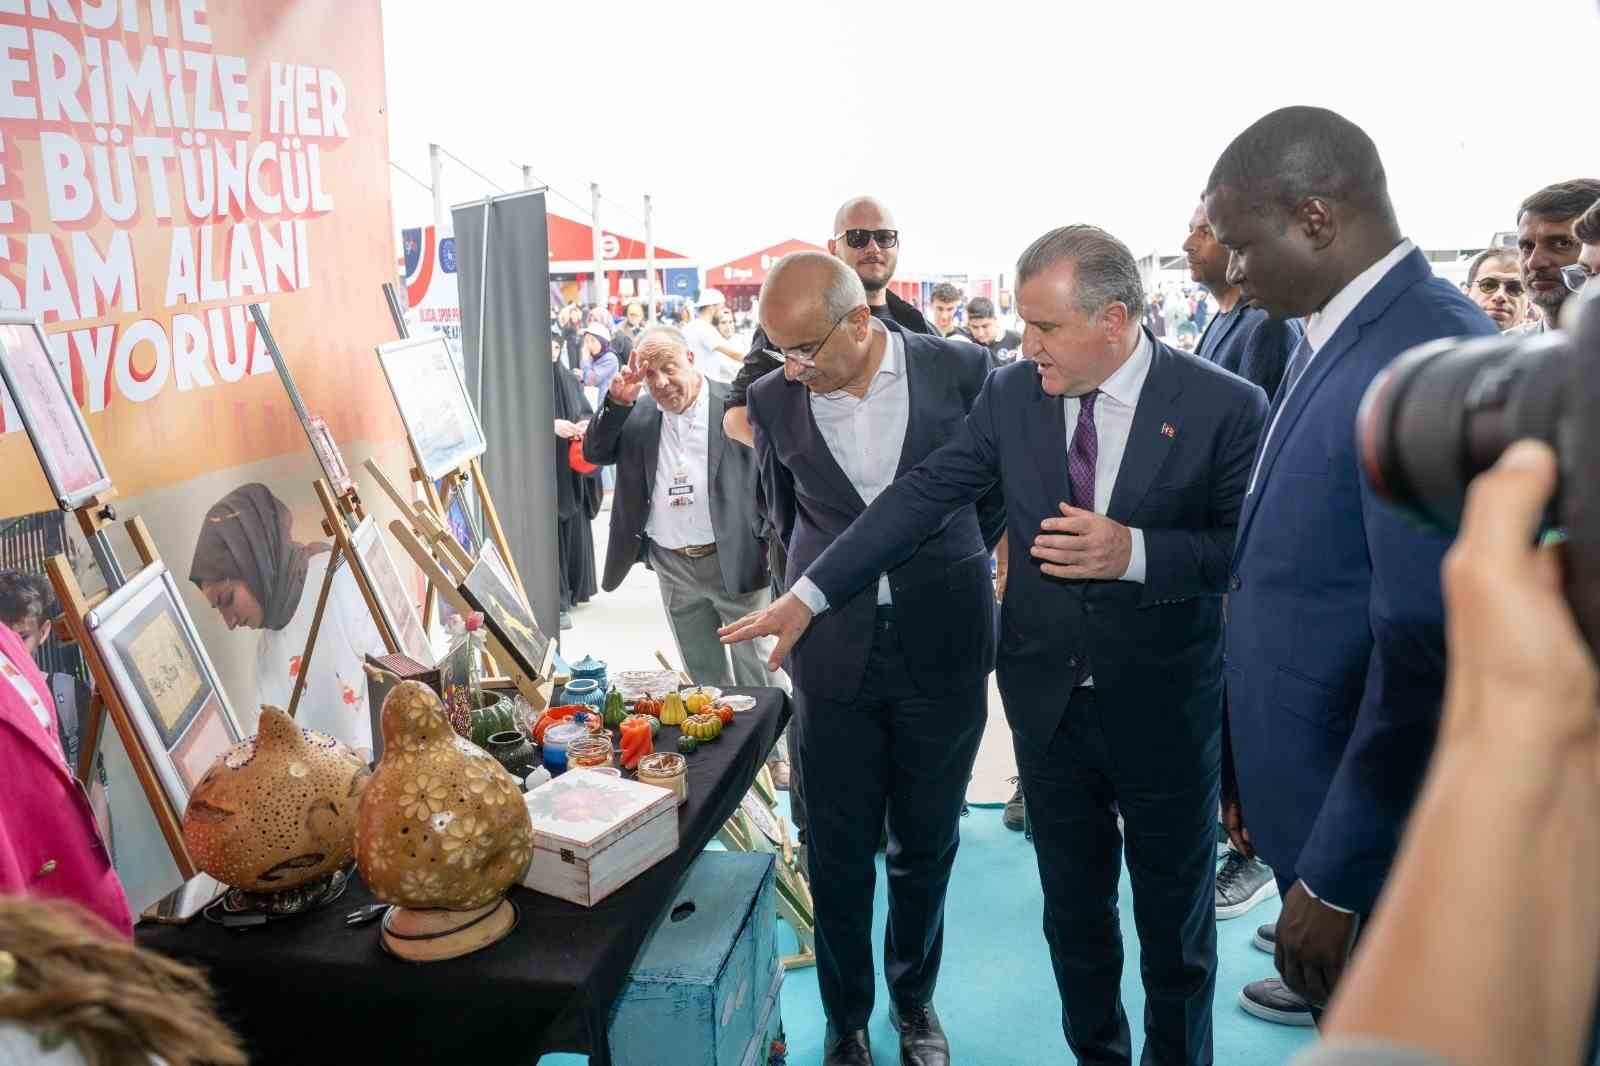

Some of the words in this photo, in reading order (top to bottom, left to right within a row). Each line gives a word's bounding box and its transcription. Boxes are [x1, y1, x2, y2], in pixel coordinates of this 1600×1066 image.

[270, 62, 349, 137] HER
[40, 127, 334, 222] BÜTÜNCÜL
[165, 221, 311, 306] ALANI
